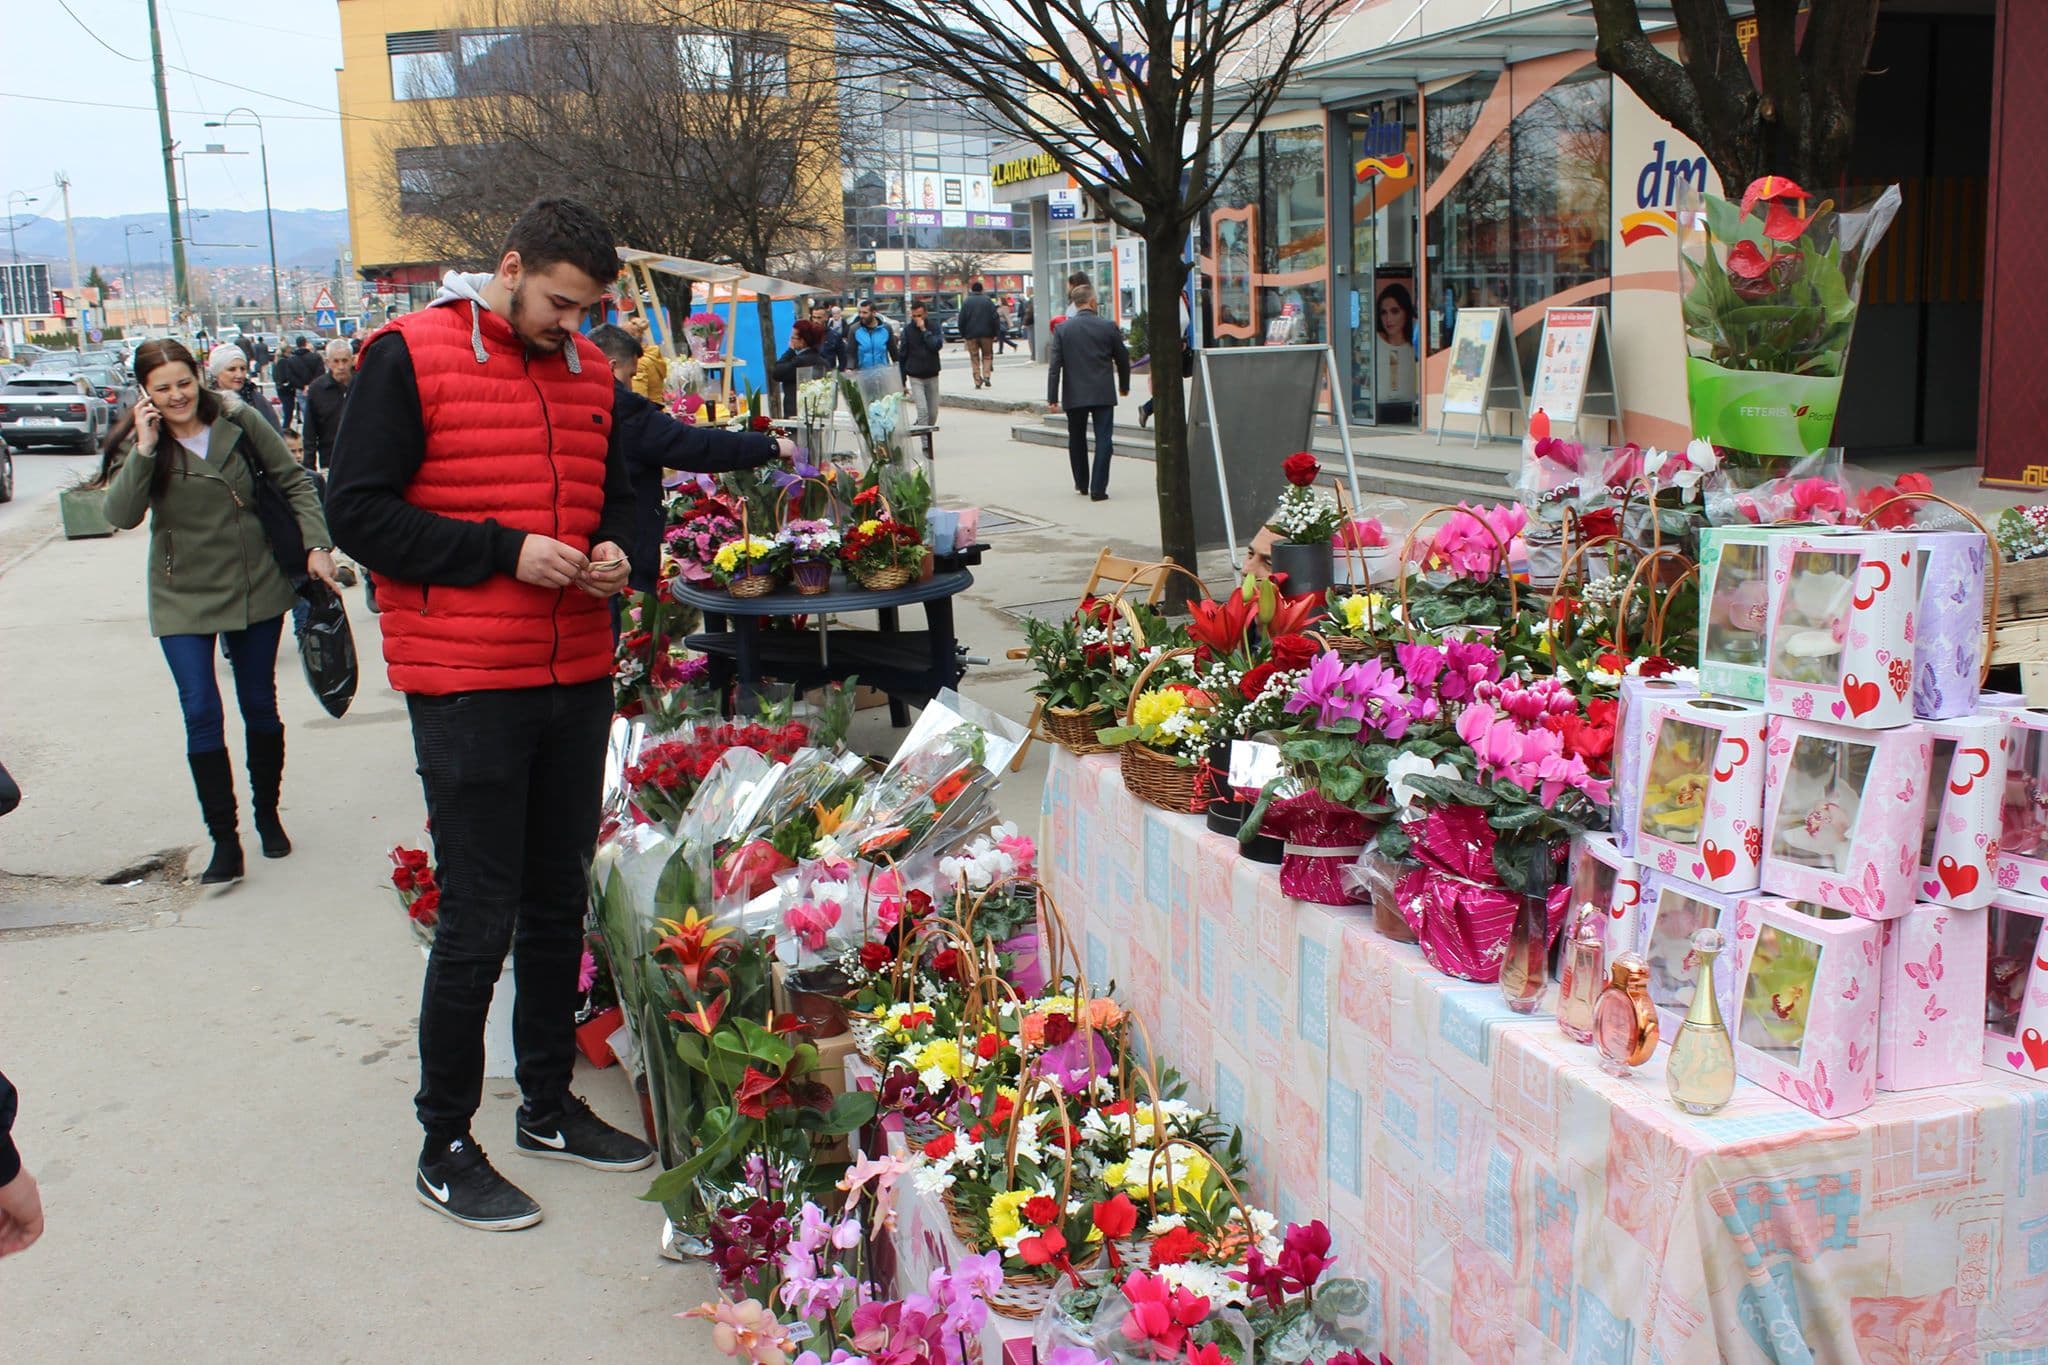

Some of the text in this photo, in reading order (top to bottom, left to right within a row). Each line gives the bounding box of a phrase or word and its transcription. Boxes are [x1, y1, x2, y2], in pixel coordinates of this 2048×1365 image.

[1363, 111, 1403, 156] dm
[991, 155, 1029, 186] ZLATAR
[1637, 139, 1708, 209] dm
[1740, 406, 1788, 417] FETERIS
